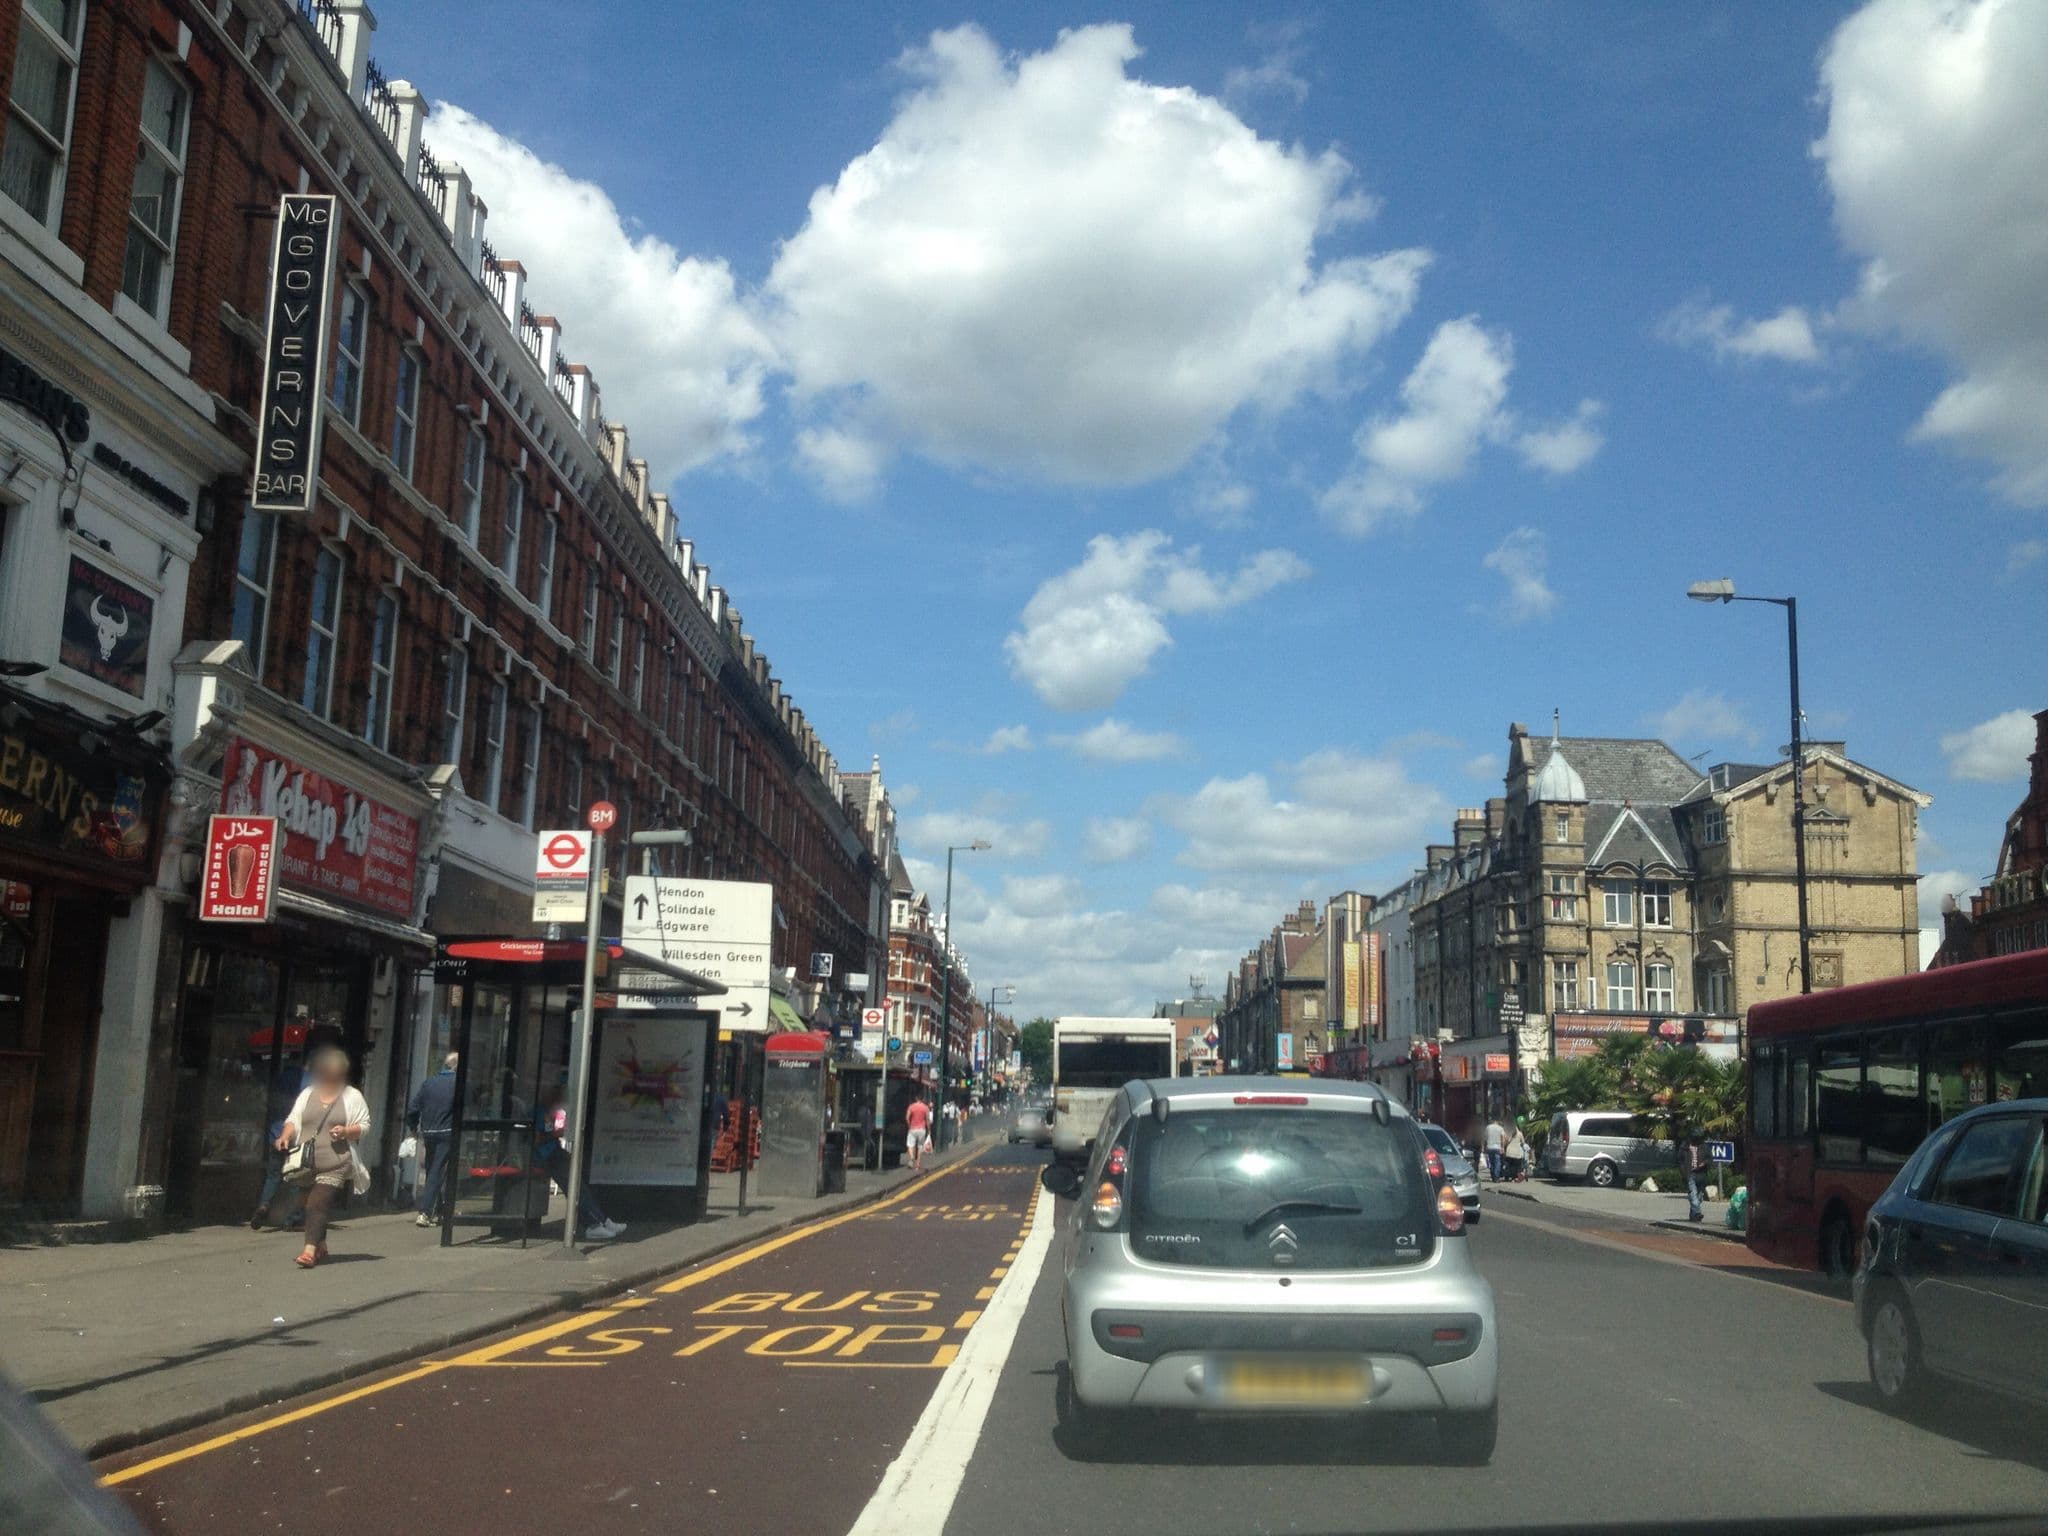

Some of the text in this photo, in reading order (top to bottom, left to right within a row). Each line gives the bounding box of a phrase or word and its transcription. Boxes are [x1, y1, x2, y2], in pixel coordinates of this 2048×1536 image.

[255, 474, 305, 495] BAR
[261, 758, 371, 862] Kebap 49
[591, 809, 614, 823] BM
[223, 821, 265, 841] حلال
[210, 842, 224, 899] KEBABS
[256, 843, 270, 900] BURGERS
[657, 885, 705, 899] Hendon
[212, 904, 259, 916] Halal
[657, 903, 716, 916] Colindale
[656, 920, 710, 933] Edgware
[661, 949, 763, 963] Willesden Green
[778, 1059, 811, 1070] Telephone
[692, 1289, 942, 1315] BUS
[545, 1323, 946, 1358] STOP
